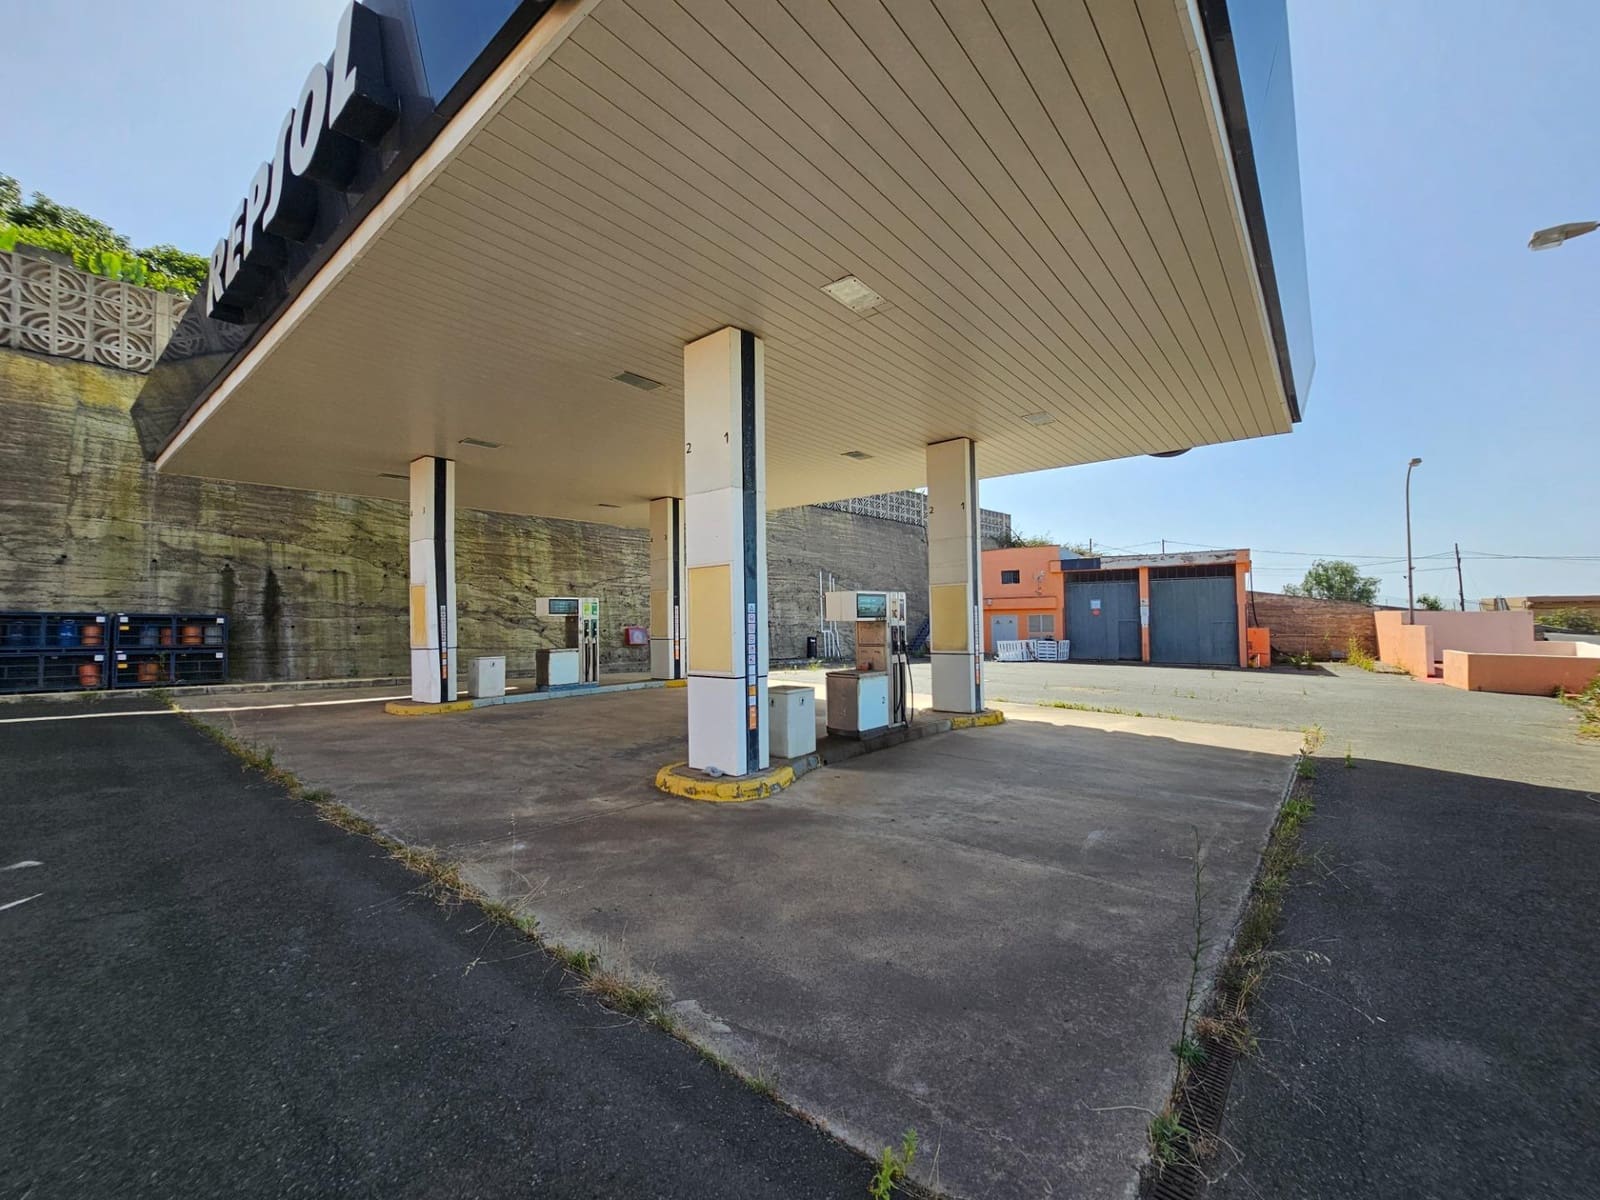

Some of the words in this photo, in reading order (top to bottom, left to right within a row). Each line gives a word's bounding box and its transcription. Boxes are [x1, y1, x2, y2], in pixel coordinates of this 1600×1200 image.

[206, 0, 357, 318] REPSOL
[723, 431, 729, 445] 1
[686, 442, 692, 454] 2
